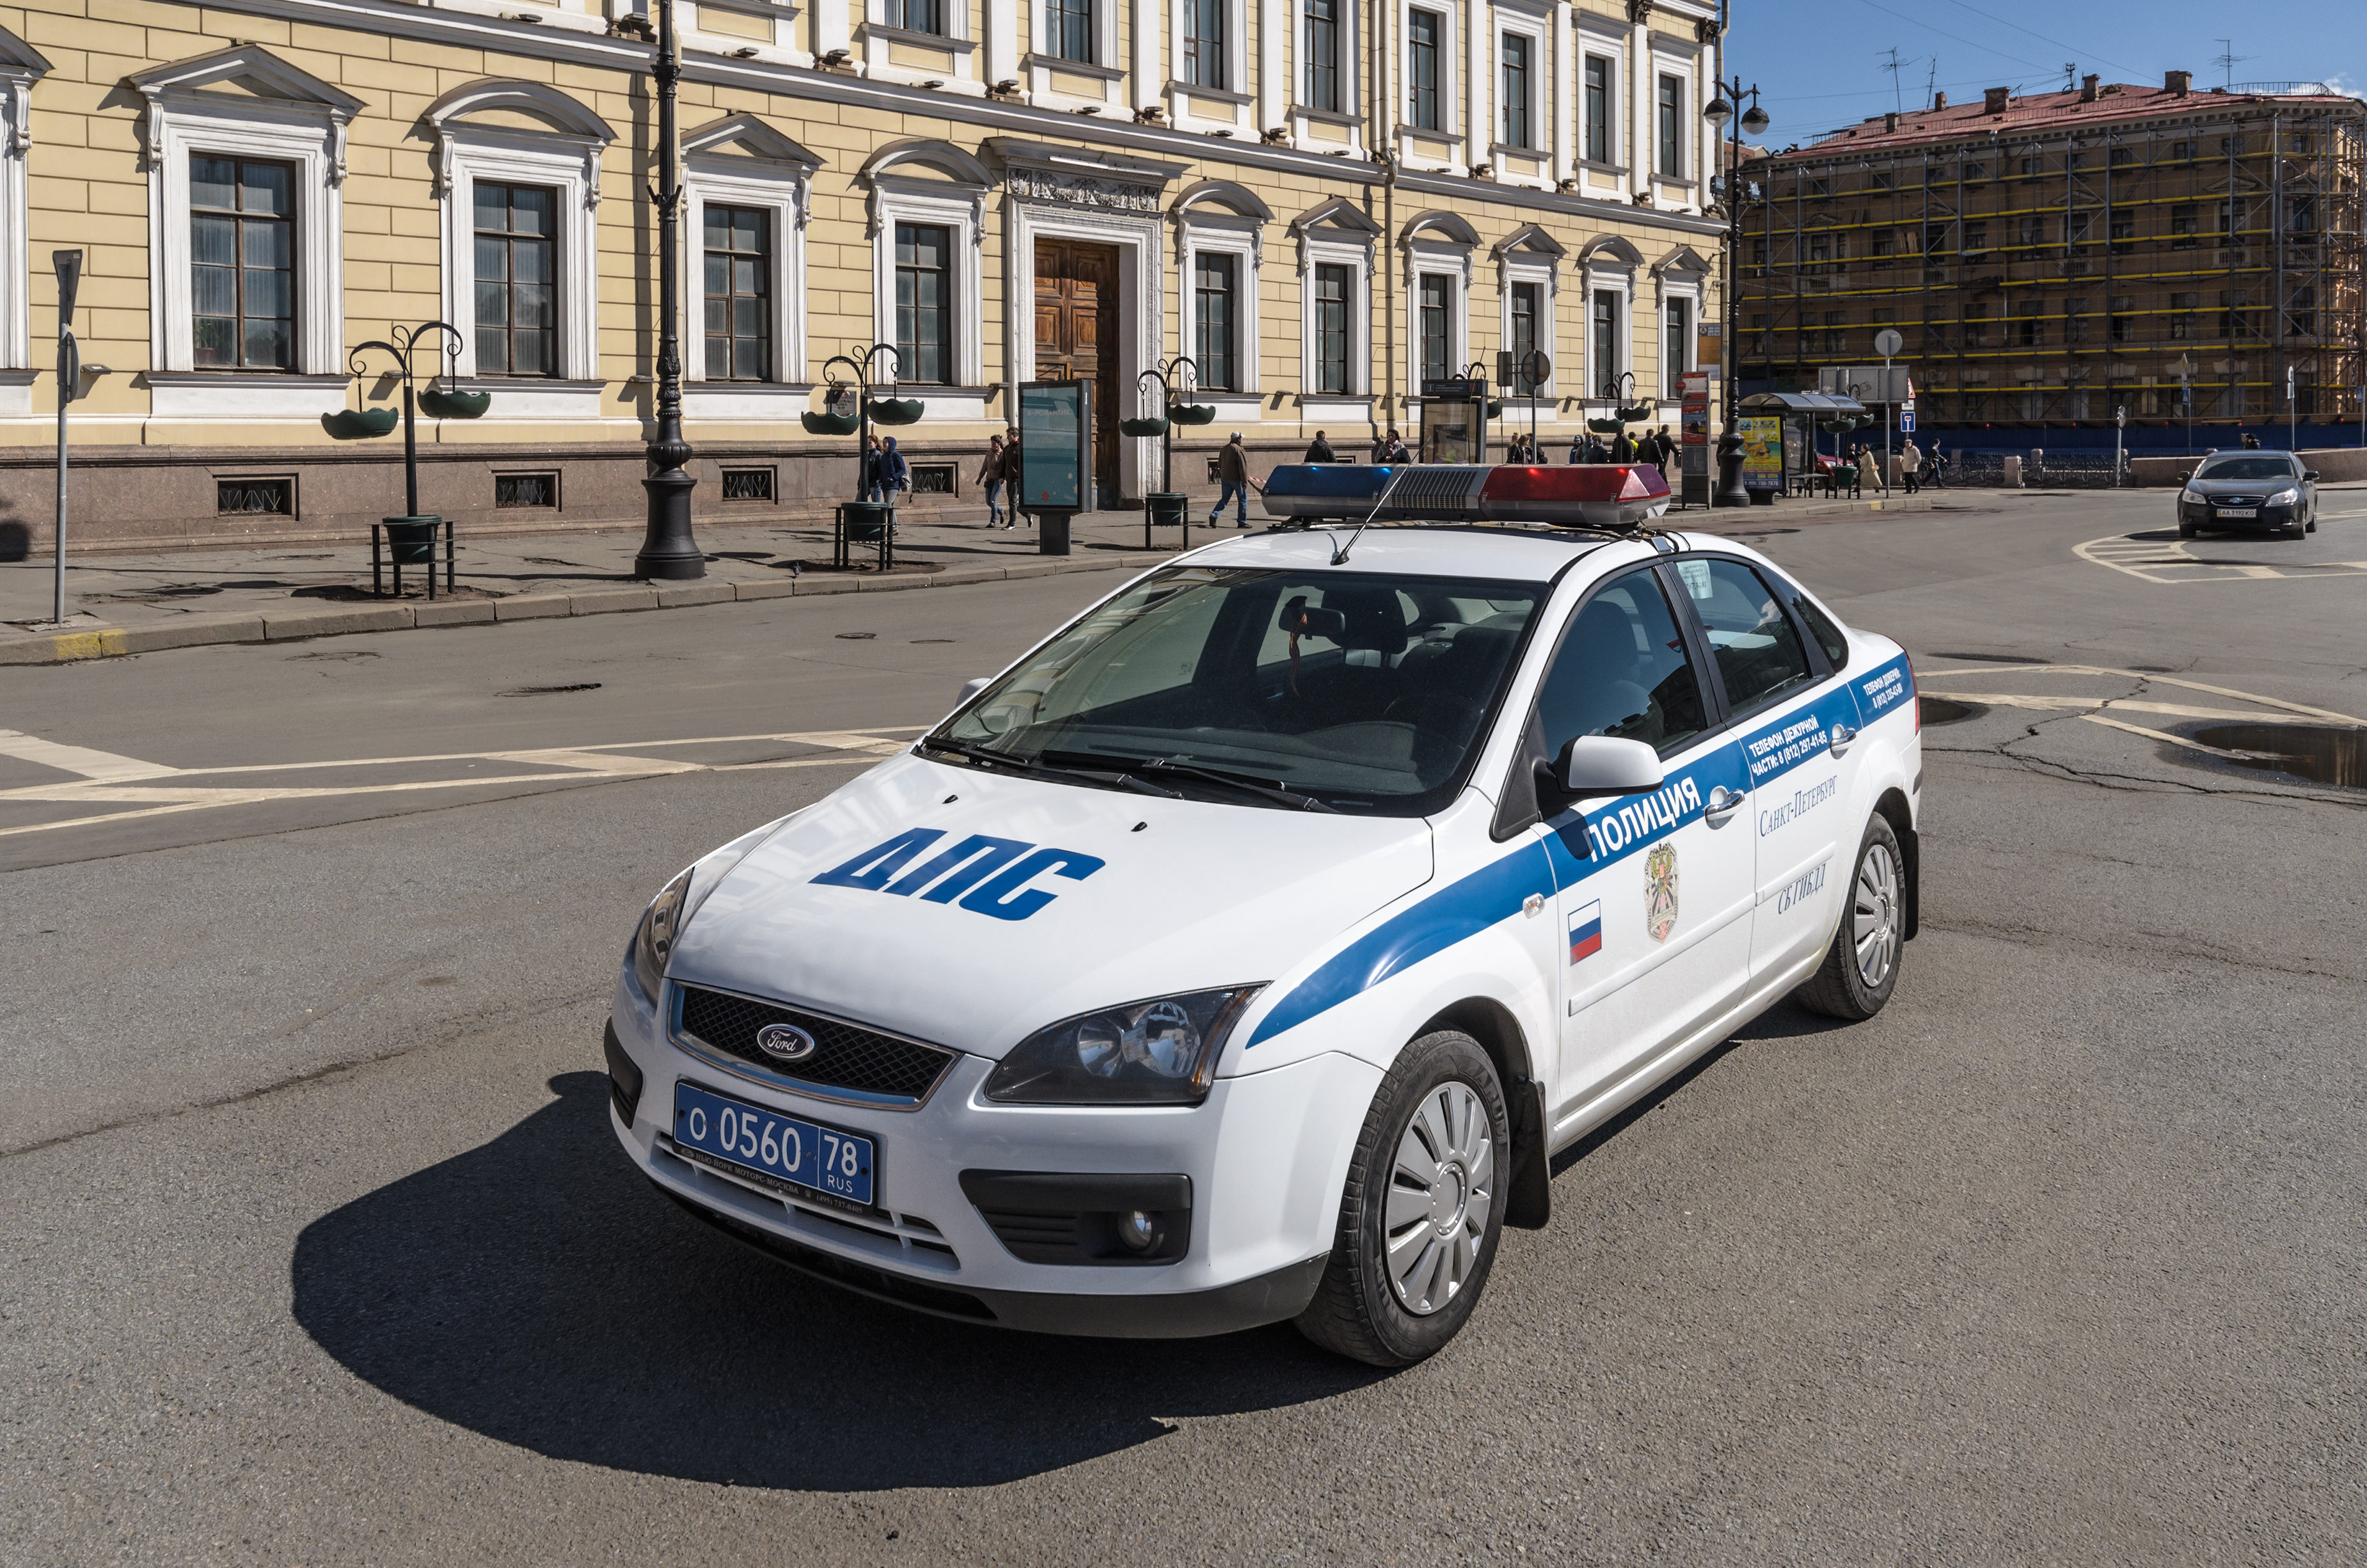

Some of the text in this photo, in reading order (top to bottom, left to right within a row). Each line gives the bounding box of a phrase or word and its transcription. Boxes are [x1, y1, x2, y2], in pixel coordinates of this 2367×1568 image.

[1863, 677, 1885, 696] ТЕЛЕФОН
[1872, 697, 1878, 709] 8
[1876, 692, 1888, 709] (812)
[1748, 714, 1819, 757] ТЕЛЕФОН ДЕЖУРНОЙ
[1751, 731, 1828, 776] ЧАСТИ: 8 (812) 297-41-85
[1582, 776, 1702, 863] ПОЛИЦИЯ
[807, 827, 1106, 921] ДПС
[1778, 863, 1826, 915] СБ ГИБДД
[768, 1030, 796, 1052] Ford
[690, 1107, 858, 1176] О 0560 78
[695, 1153, 863, 1214] НЬЮ-ЙОРК МОТОРС-МОСКВА (495) 737-0405
[827, 1175, 853, 1193] RUS
